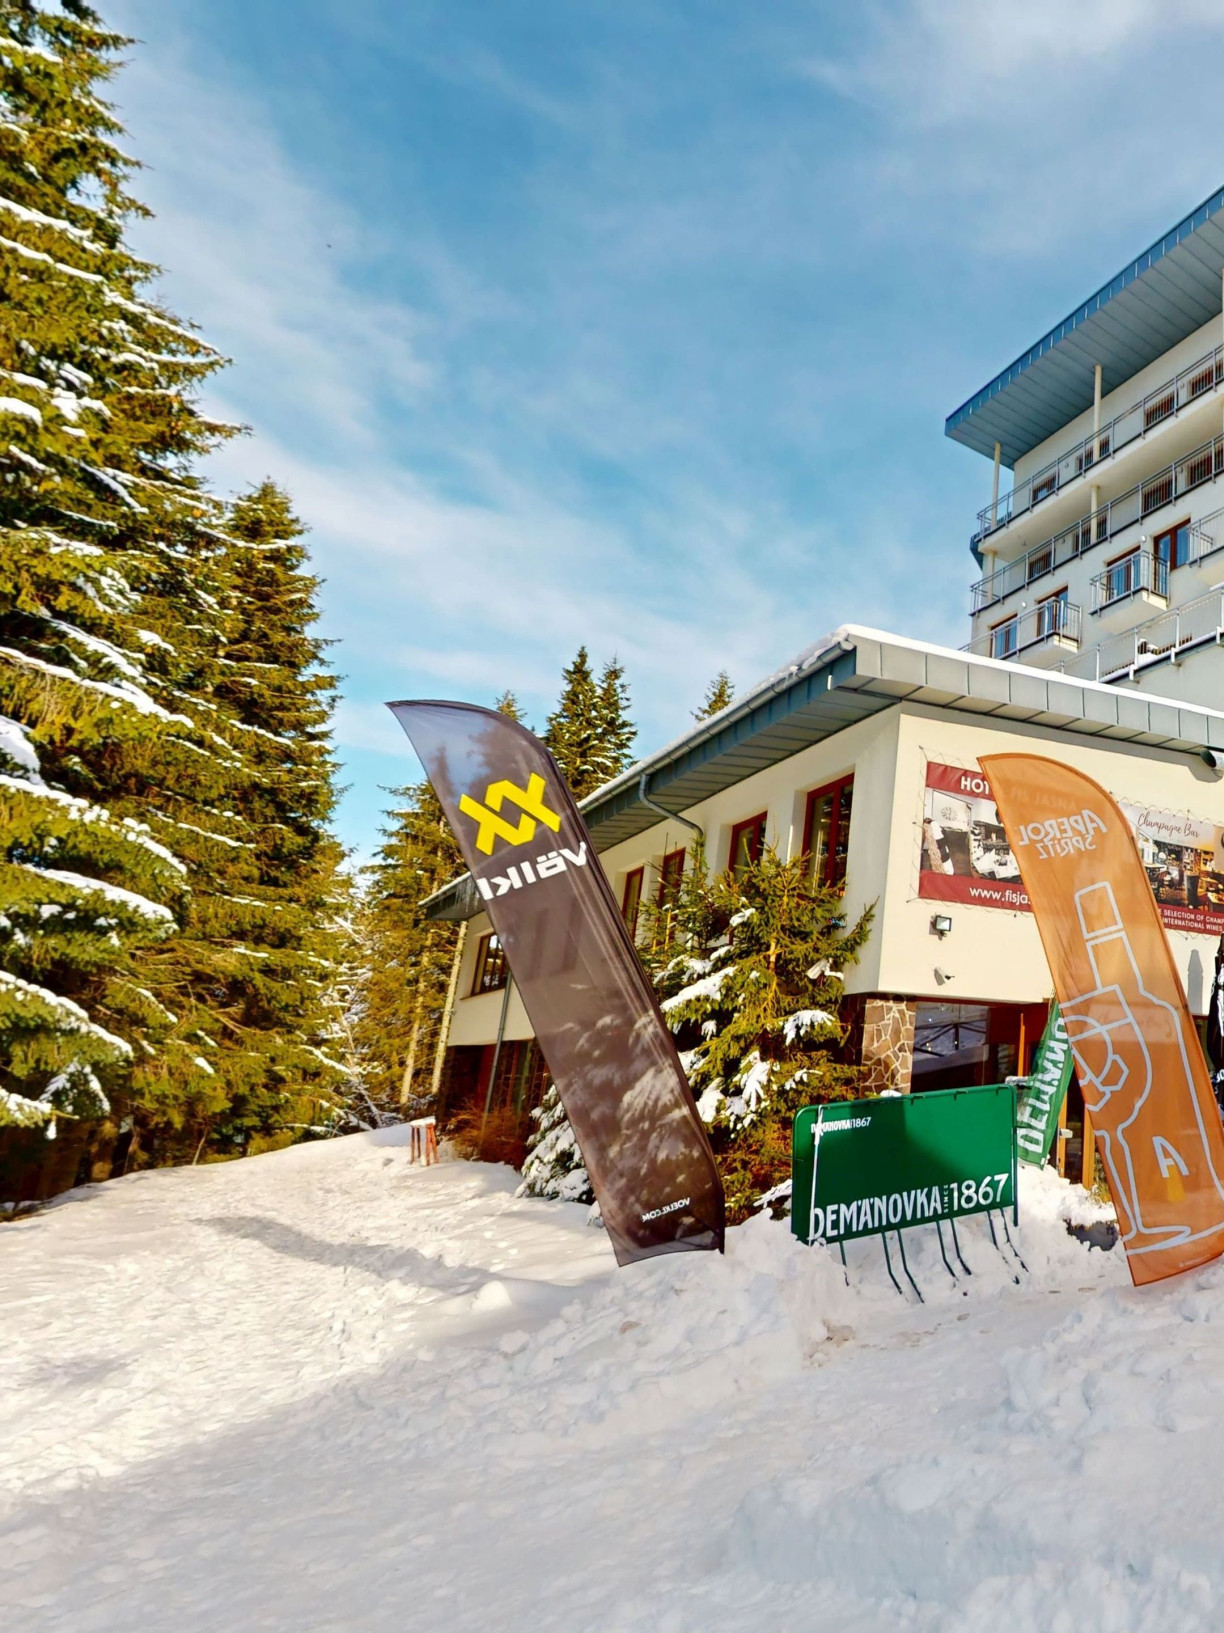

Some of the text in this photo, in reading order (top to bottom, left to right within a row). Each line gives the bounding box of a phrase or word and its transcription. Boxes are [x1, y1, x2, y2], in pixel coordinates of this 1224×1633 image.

[1137, 811, 1200, 839] Champagne Bar
[1163, 909, 1195, 920] SELECTION
[1162, 917, 1223, 932] INTERNATIONAL WINES
[852, 1116, 872, 1129] 1867
[812, 1186, 942, 1240] DEMÄNOVKA
[950, 1173, 1009, 1211] 1867
